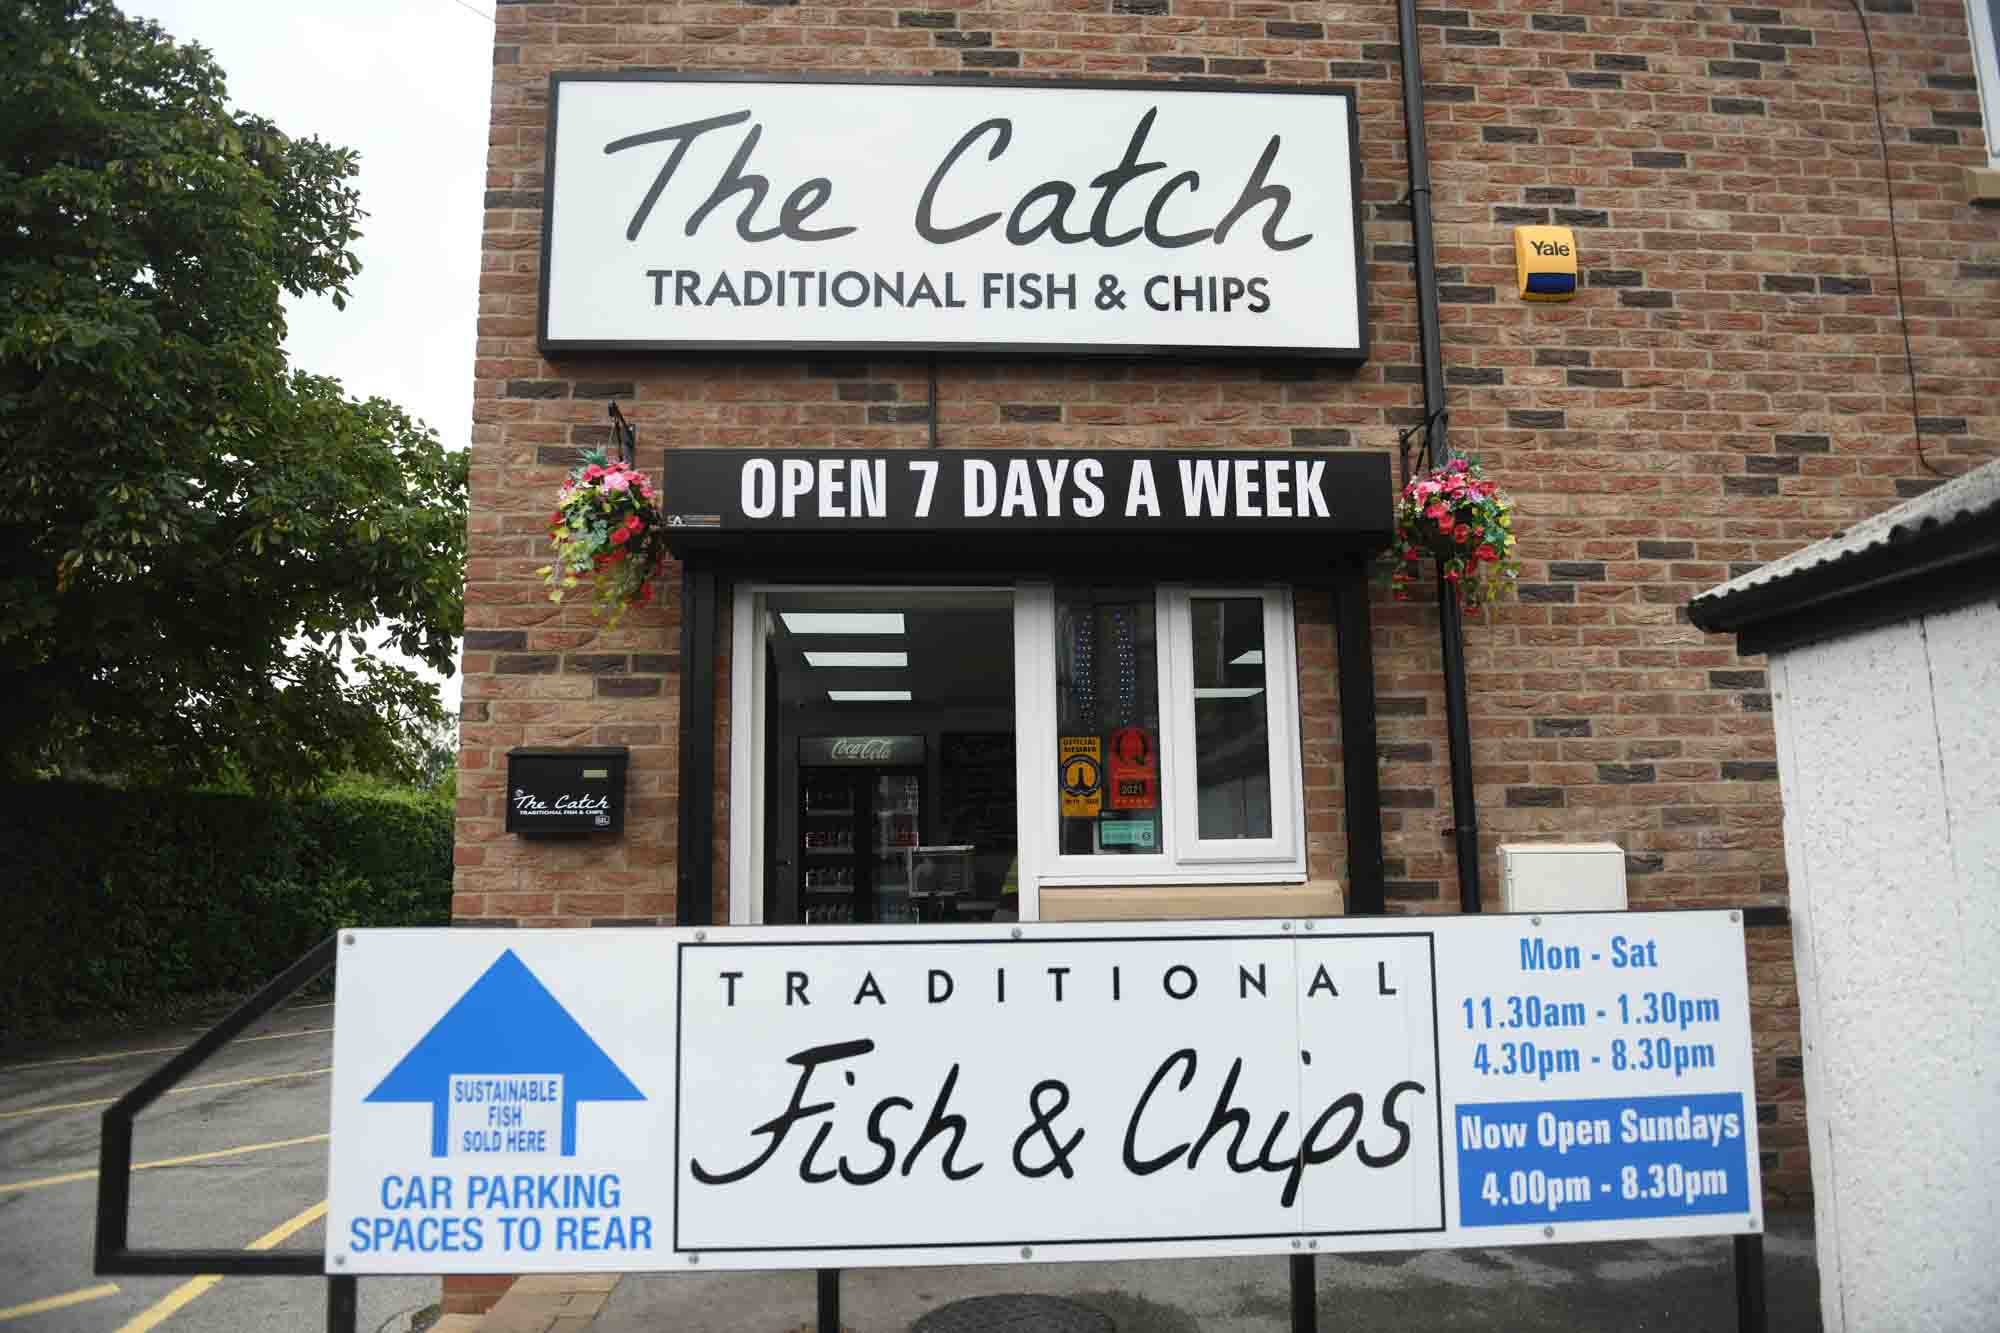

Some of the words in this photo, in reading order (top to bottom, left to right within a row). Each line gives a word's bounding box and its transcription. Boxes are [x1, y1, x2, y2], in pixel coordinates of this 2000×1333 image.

[604, 109, 857, 243] The
[914, 105, 1313, 252] Catch
[1530, 240, 1571, 257] Yale
[646, 269, 966, 308] TRADITIONAL
[983, 272, 1077, 310] FISH
[1094, 274, 1127, 311] &
[1143, 275, 1271, 314] CHIPS
[740, 457, 887, 519] OPEN
[908, 460, 940, 518] 7
[963, 458, 1105, 518] DAYS
[1124, 459, 1161, 517] A
[1178, 459, 1331, 518] WEEK
[513, 794, 547, 809] The
[554, 793, 610, 809] Catch
[1519, 936, 1582, 972] Mon
[1610, 935, 1657, 969] Sat
[719, 961, 1398, 1007] TRADITIONAL
[1462, 995, 1586, 1030] 11.30am
[1618, 991, 1721, 1029] 1.30pm
[1473, 1040, 1581, 1080] 4.30pm
[1611, 1037, 1716, 1076] 8.30pm
[454, 1079, 558, 1105] SUSTAINABLE
[487, 1103, 524, 1128] FISH
[690, 1038, 984, 1186] Fish
[1012, 1079, 1086, 1180] &
[1122, 1048, 1426, 1209] Chips
[1461, 1114, 1527, 1150] Now
[1537, 1111, 1611, 1153] Open
[1620, 1106, 1740, 1147] Sundays
[462, 1130, 504, 1154] SOLD
[506, 1129, 547, 1153] HERE
[380, 1174, 455, 1212] CAR
[467, 1172, 622, 1210] PARKING
[1481, 1170, 1591, 1211] 4.00pm
[1621, 1163, 1728, 1204] 8.30pm
[350, 1216, 485, 1253] SPACES
[496, 1215, 543, 1254] TO
[555, 1215, 653, 1251] REAR
